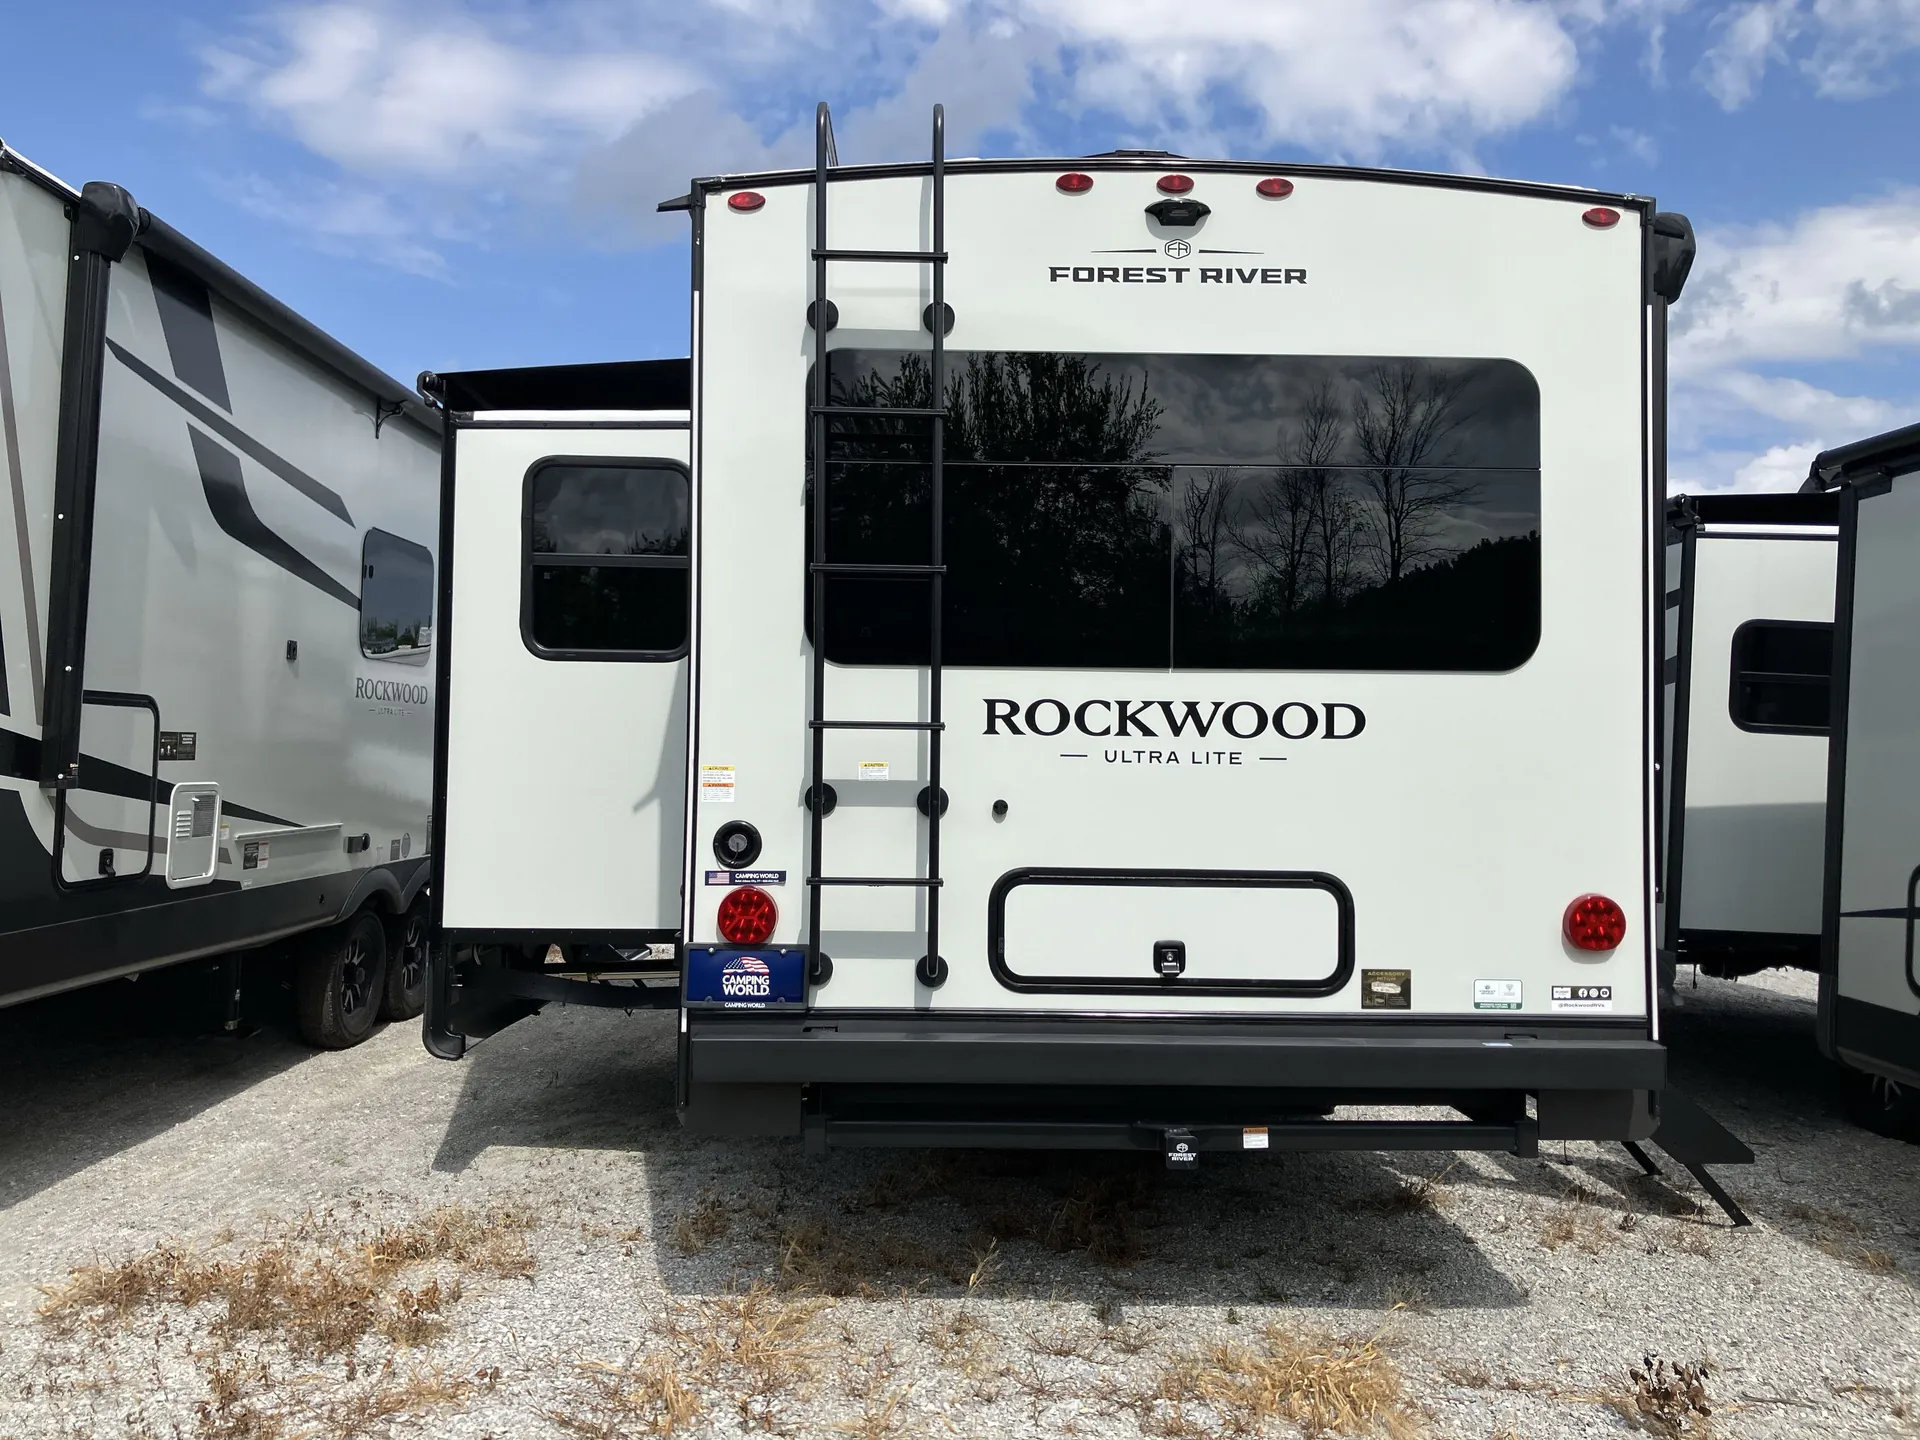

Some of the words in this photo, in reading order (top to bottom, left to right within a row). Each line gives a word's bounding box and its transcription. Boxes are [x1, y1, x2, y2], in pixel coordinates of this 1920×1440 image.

[1048, 266, 1191, 283] FOREST
[1198, 267, 1308, 285] RIVER
[355, 677, 428, 705] ROCKWOOD
[377, 707, 394, 716] ULTRA
[981, 698, 1367, 740] ROCKWOOD
[1104, 749, 1180, 764] ULTRA
[1191, 750, 1243, 765] LITE
[722, 974, 770, 985] CAMPING
[722, 984, 770, 996] WORLD
